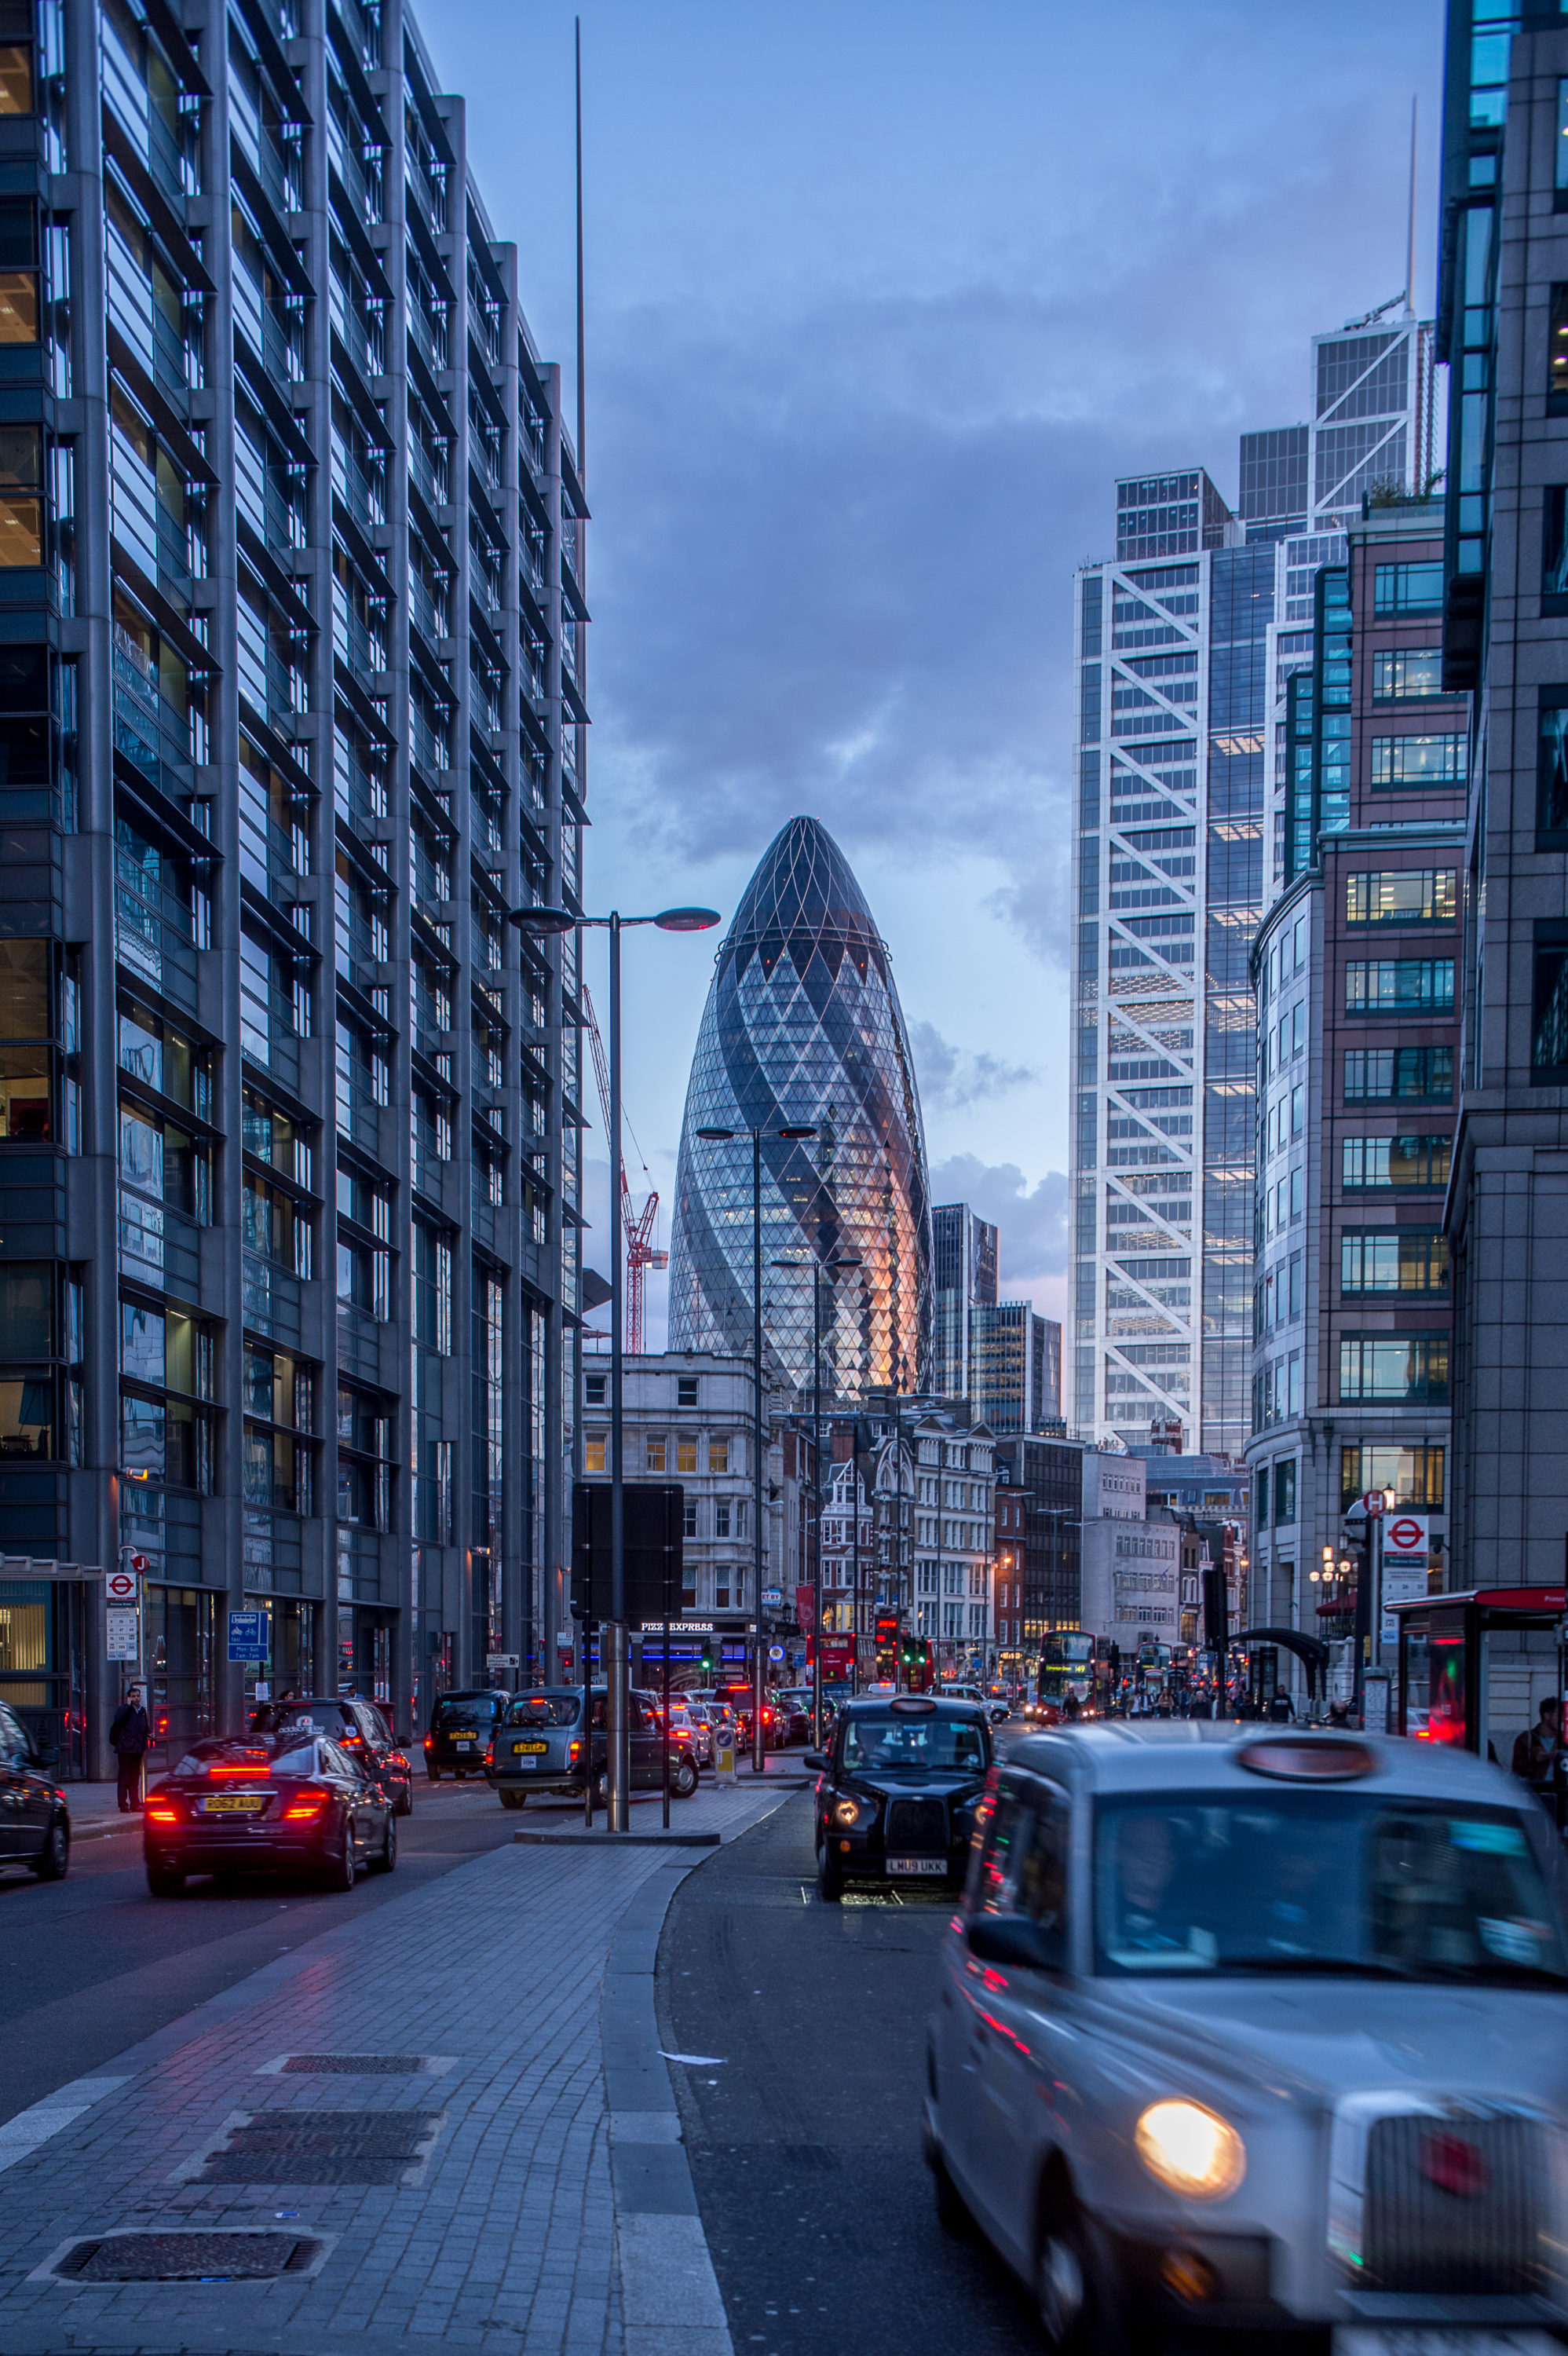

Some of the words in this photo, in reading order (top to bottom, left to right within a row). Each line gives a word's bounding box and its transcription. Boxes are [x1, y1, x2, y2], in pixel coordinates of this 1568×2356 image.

[1368, 1494, 1383, 1511] H
[137, 1557, 145, 1570] J
[641, 1622, 664, 1631] PIZZ
[668, 1622, 714, 1631] EXPRESS
[921, 1860, 941, 1872] UKK
